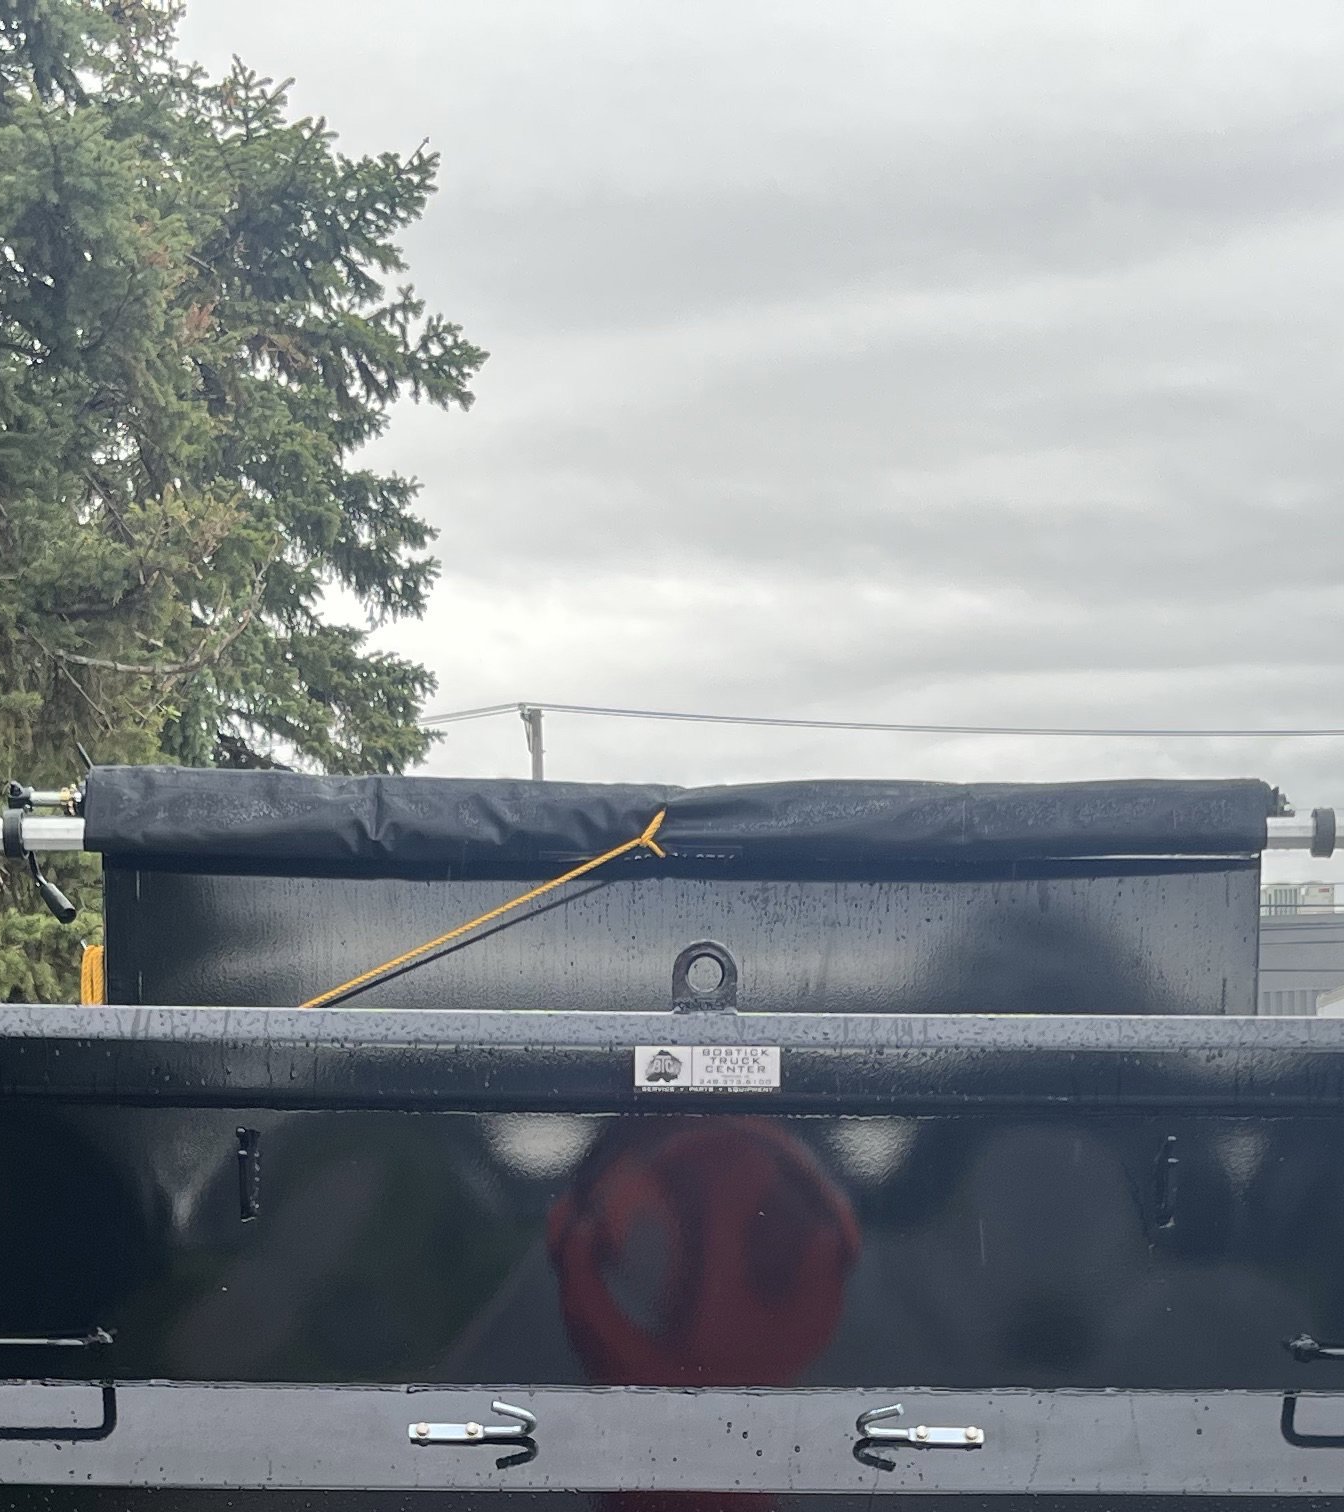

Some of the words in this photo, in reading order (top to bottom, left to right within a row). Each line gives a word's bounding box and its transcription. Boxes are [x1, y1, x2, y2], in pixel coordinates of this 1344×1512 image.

[702, 1048, 769, 1056] BOSTICK
[653, 1055, 674, 1073] BTC
[710, 1057, 760, 1065] TRUCK
[705, 1065, 766, 1073] CENTER
